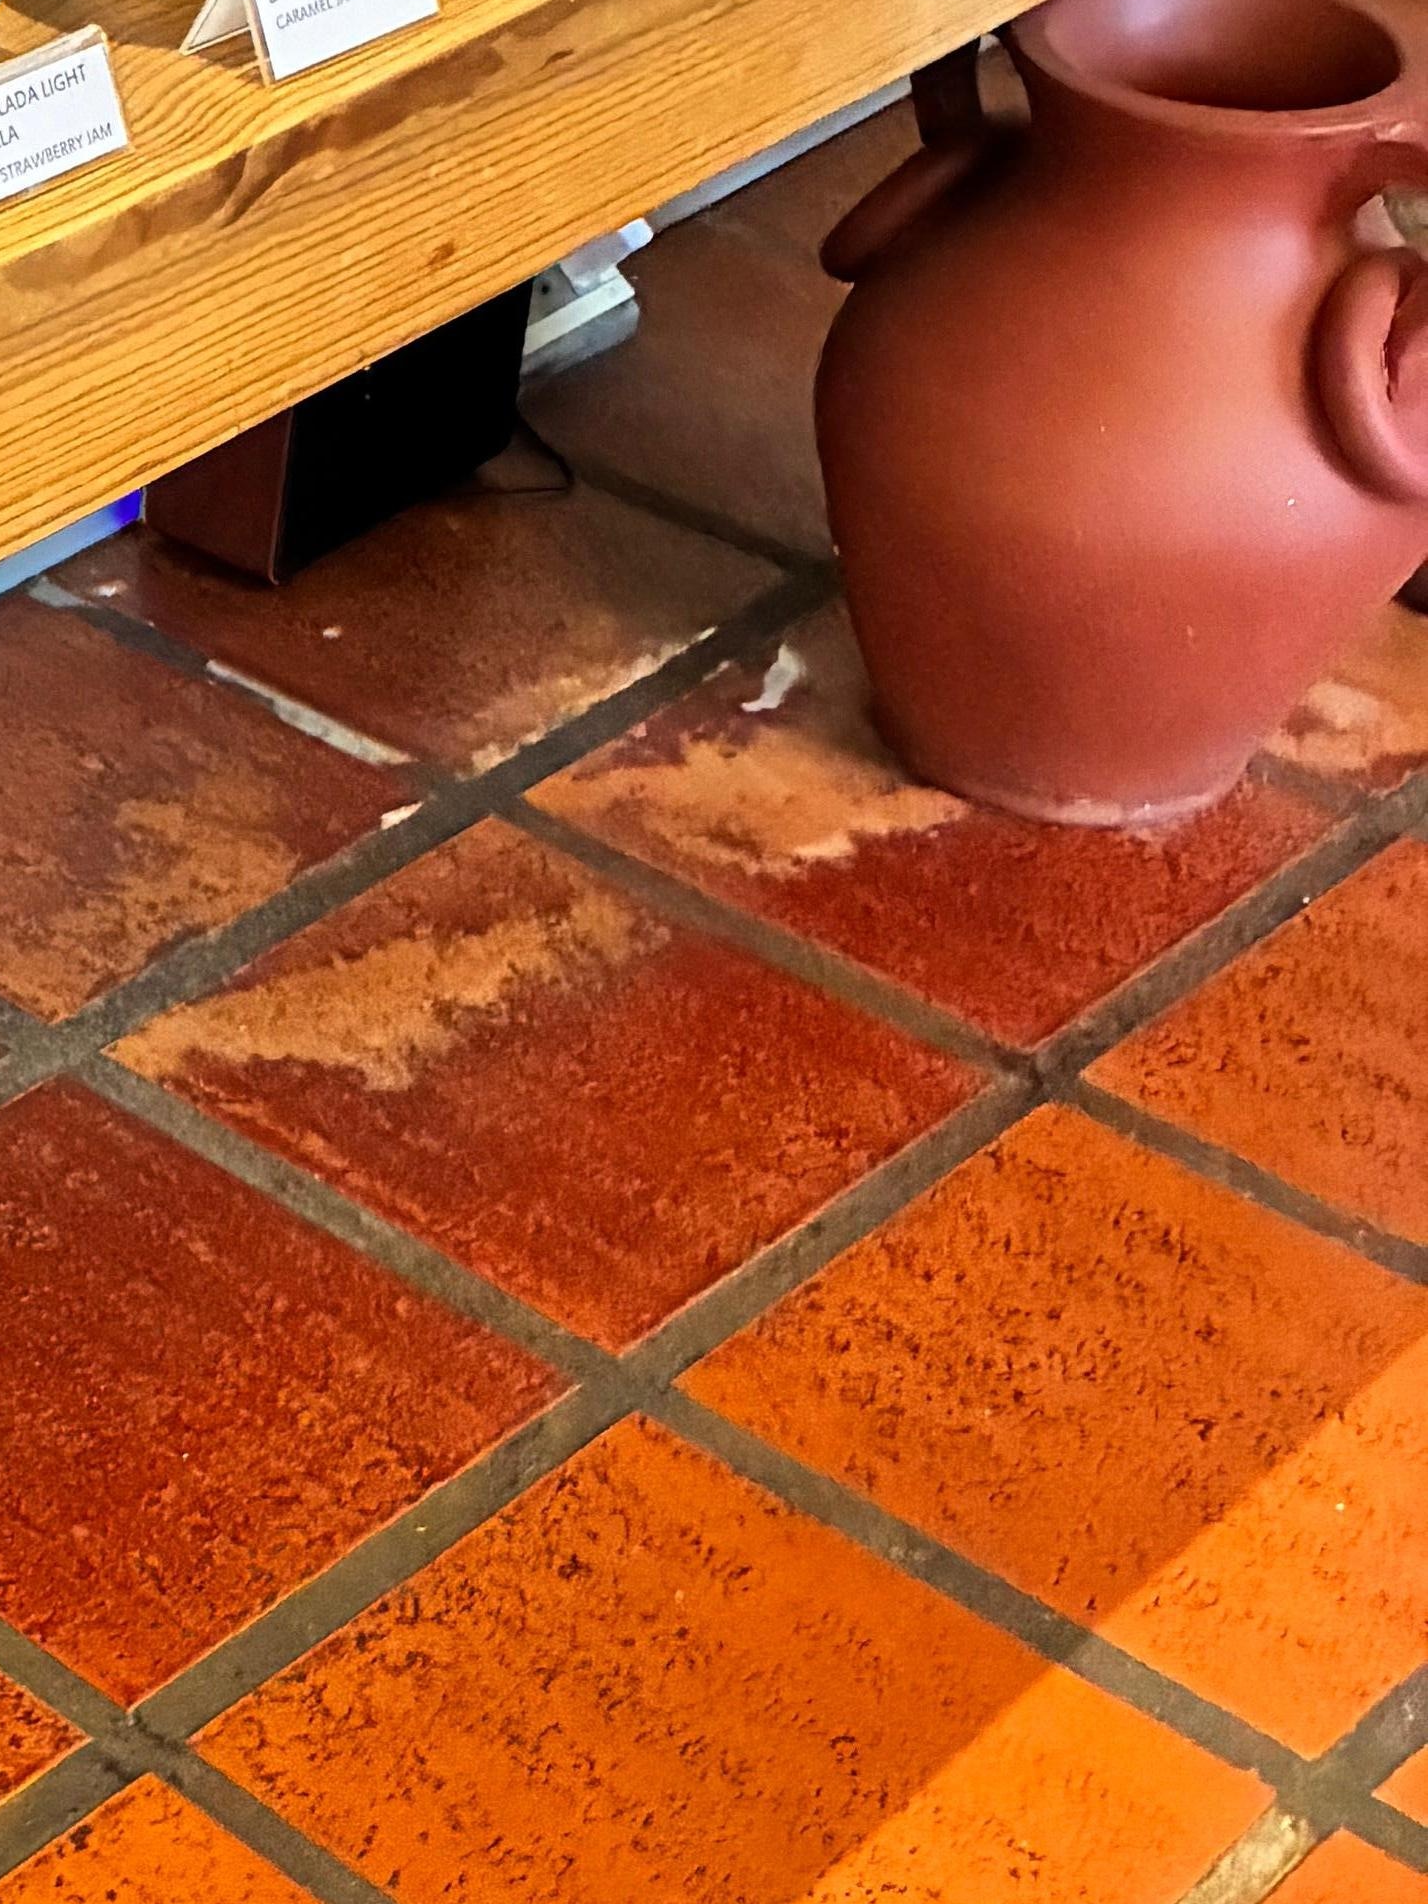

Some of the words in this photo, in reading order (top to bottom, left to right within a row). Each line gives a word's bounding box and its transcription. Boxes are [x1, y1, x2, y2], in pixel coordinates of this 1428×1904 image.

[41, 63, 87, 97] LIGHT
[0, 133, 85, 183] STRAWBERRY
[86, 122, 113, 147] JAM
